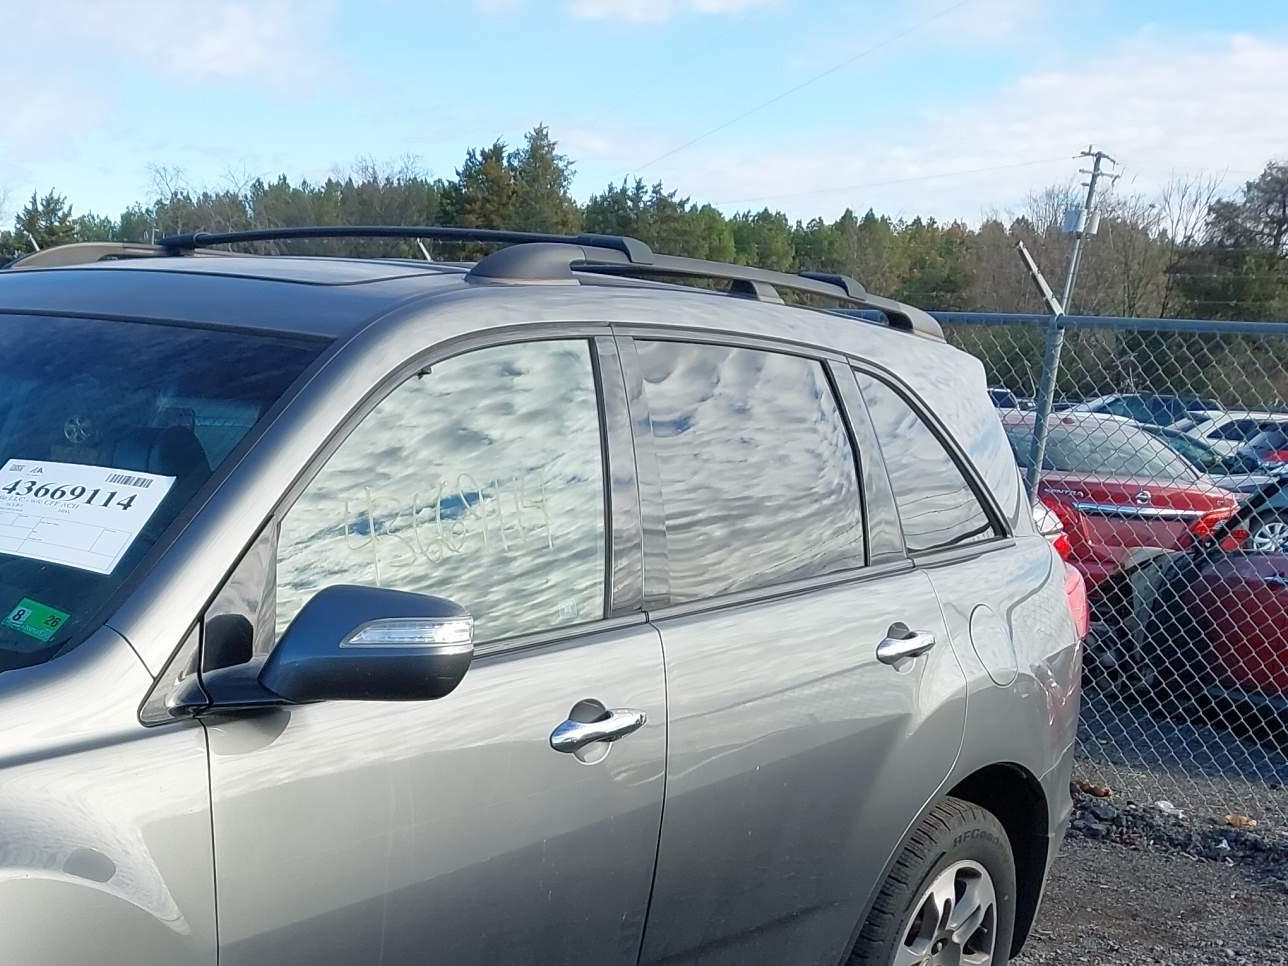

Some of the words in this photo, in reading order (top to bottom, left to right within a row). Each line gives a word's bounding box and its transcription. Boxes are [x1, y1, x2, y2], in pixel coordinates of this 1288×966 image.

[2, 479, 138, 512] 43669114
[12, 609, 26, 621] 8
[44, 615, 62, 628] 26
